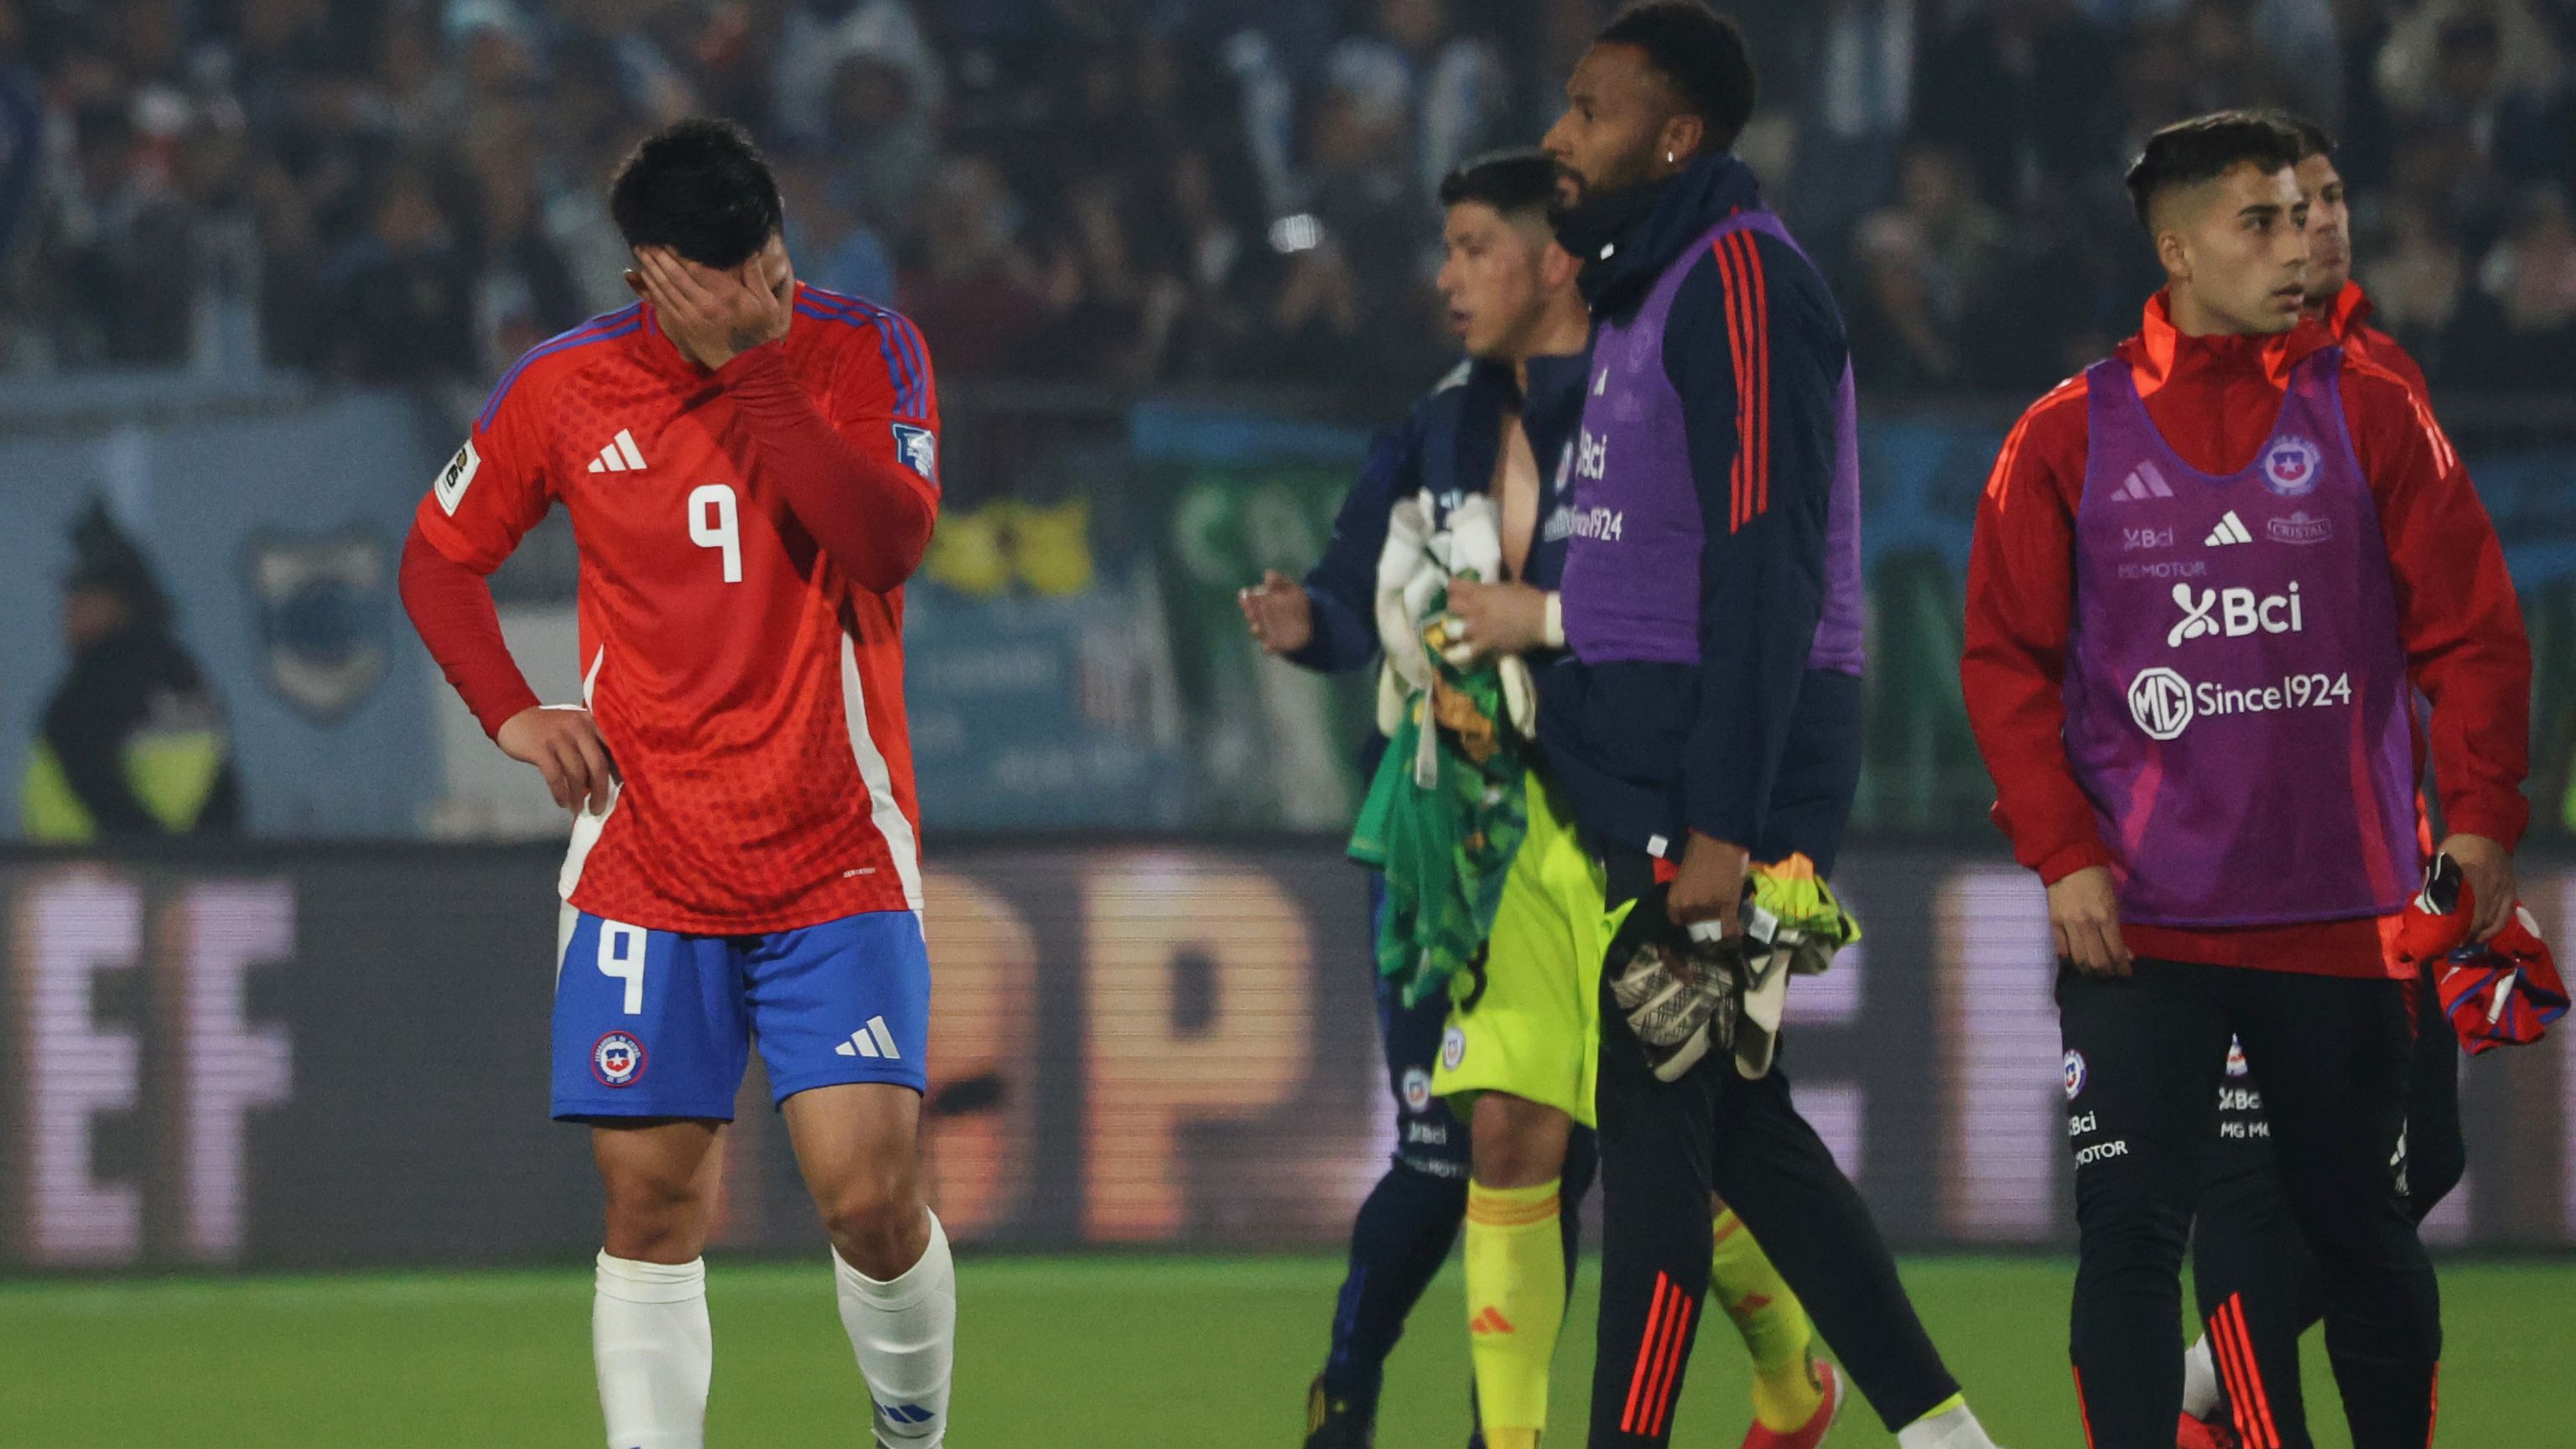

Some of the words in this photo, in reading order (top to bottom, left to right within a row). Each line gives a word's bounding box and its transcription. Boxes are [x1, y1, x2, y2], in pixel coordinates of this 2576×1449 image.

[688, 483, 743, 584] 9
[597, 918, 648, 1015] 9
[2220, 1121, 2245, 1138] MG
